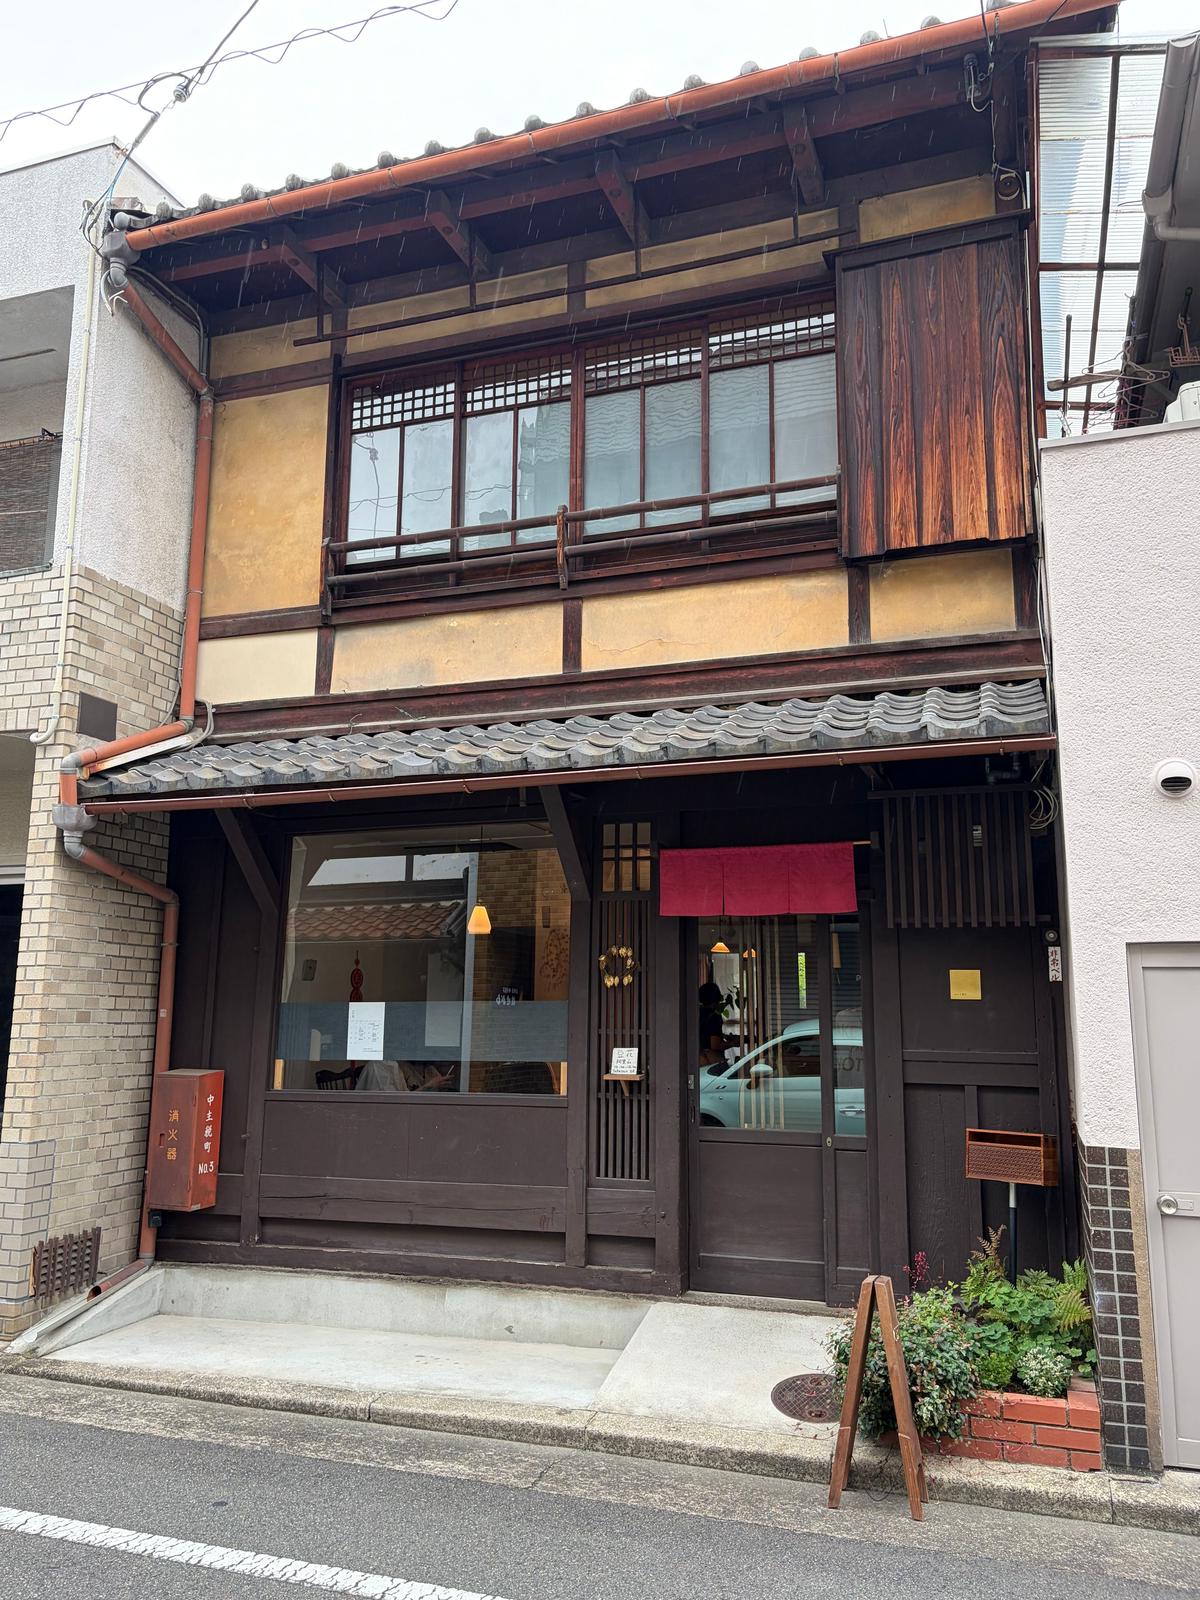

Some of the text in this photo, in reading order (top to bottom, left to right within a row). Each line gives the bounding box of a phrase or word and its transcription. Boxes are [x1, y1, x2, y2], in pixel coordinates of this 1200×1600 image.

[166, 1109, 180, 1161] 消火器
[203, 1093, 215, 1153] 中主税町
